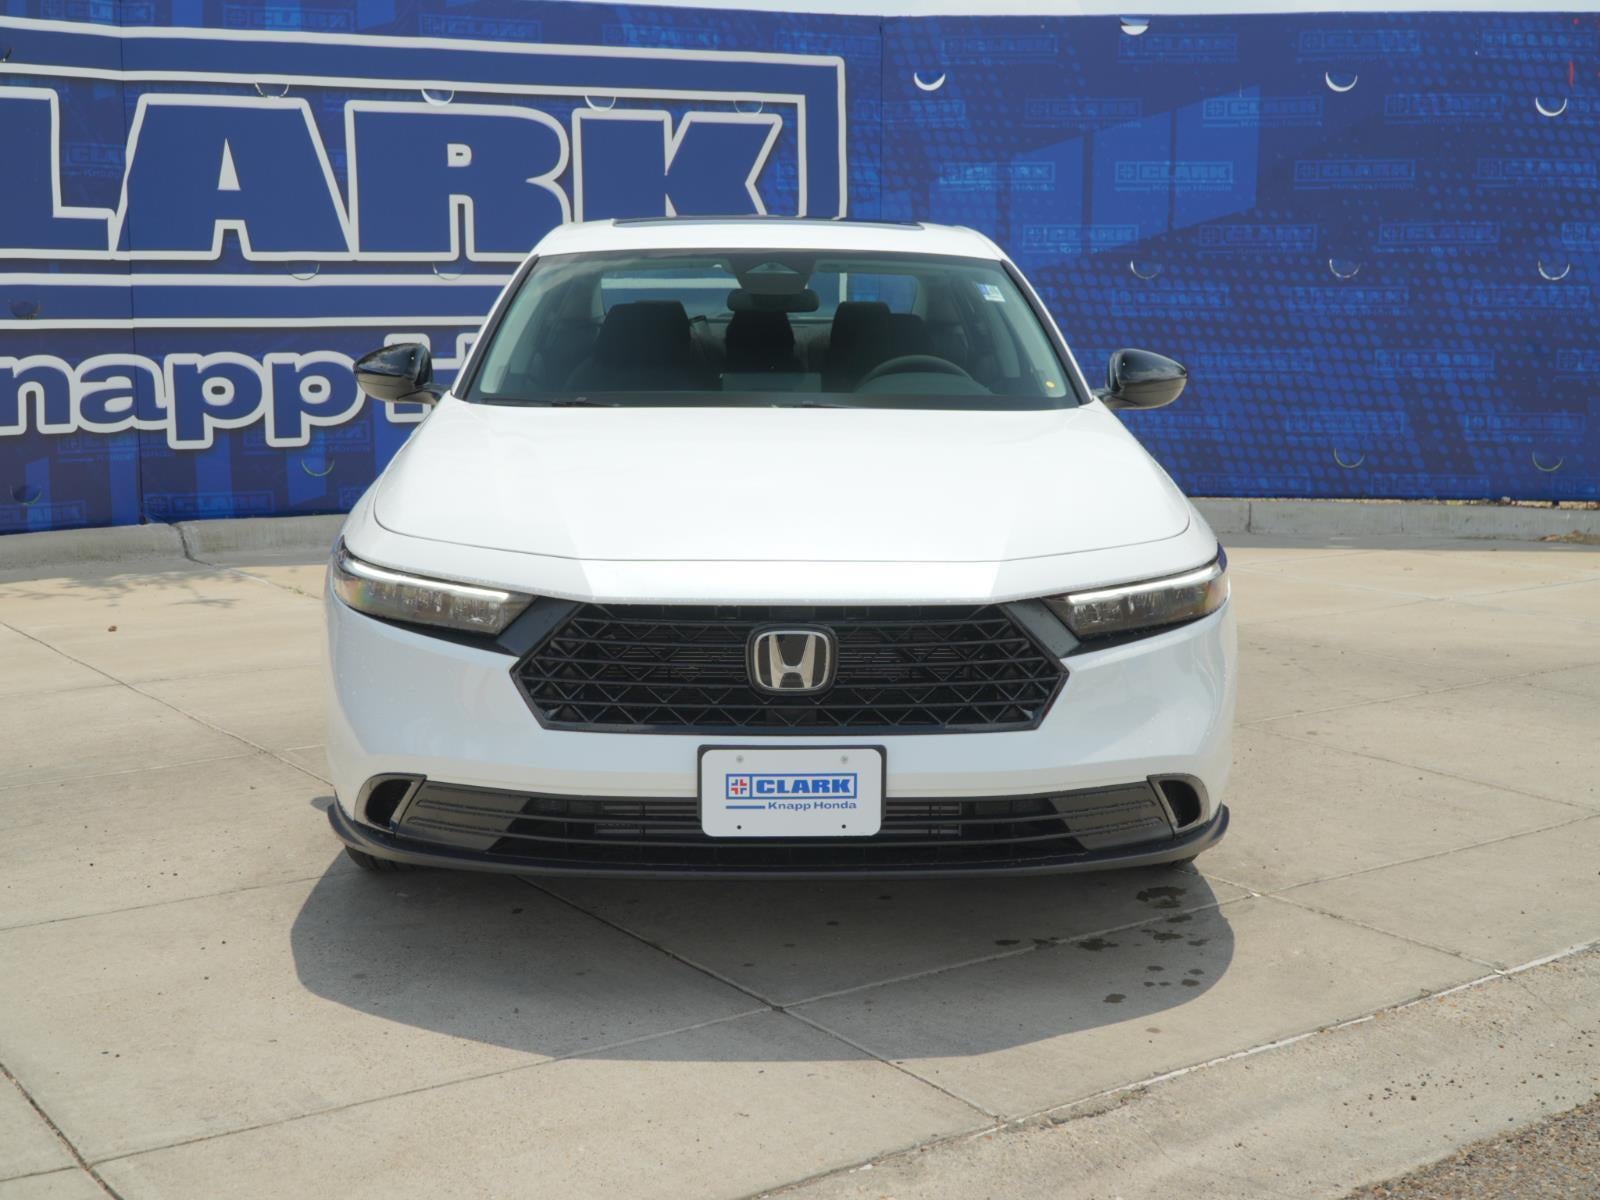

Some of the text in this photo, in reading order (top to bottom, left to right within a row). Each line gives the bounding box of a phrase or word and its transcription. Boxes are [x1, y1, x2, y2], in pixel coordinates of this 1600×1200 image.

[0, 87, 783, 260] LARK
[0, 350, 367, 450] napp
[756, 778, 851, 794] CLARK
[767, 801, 857, 811] Knapp Honda
